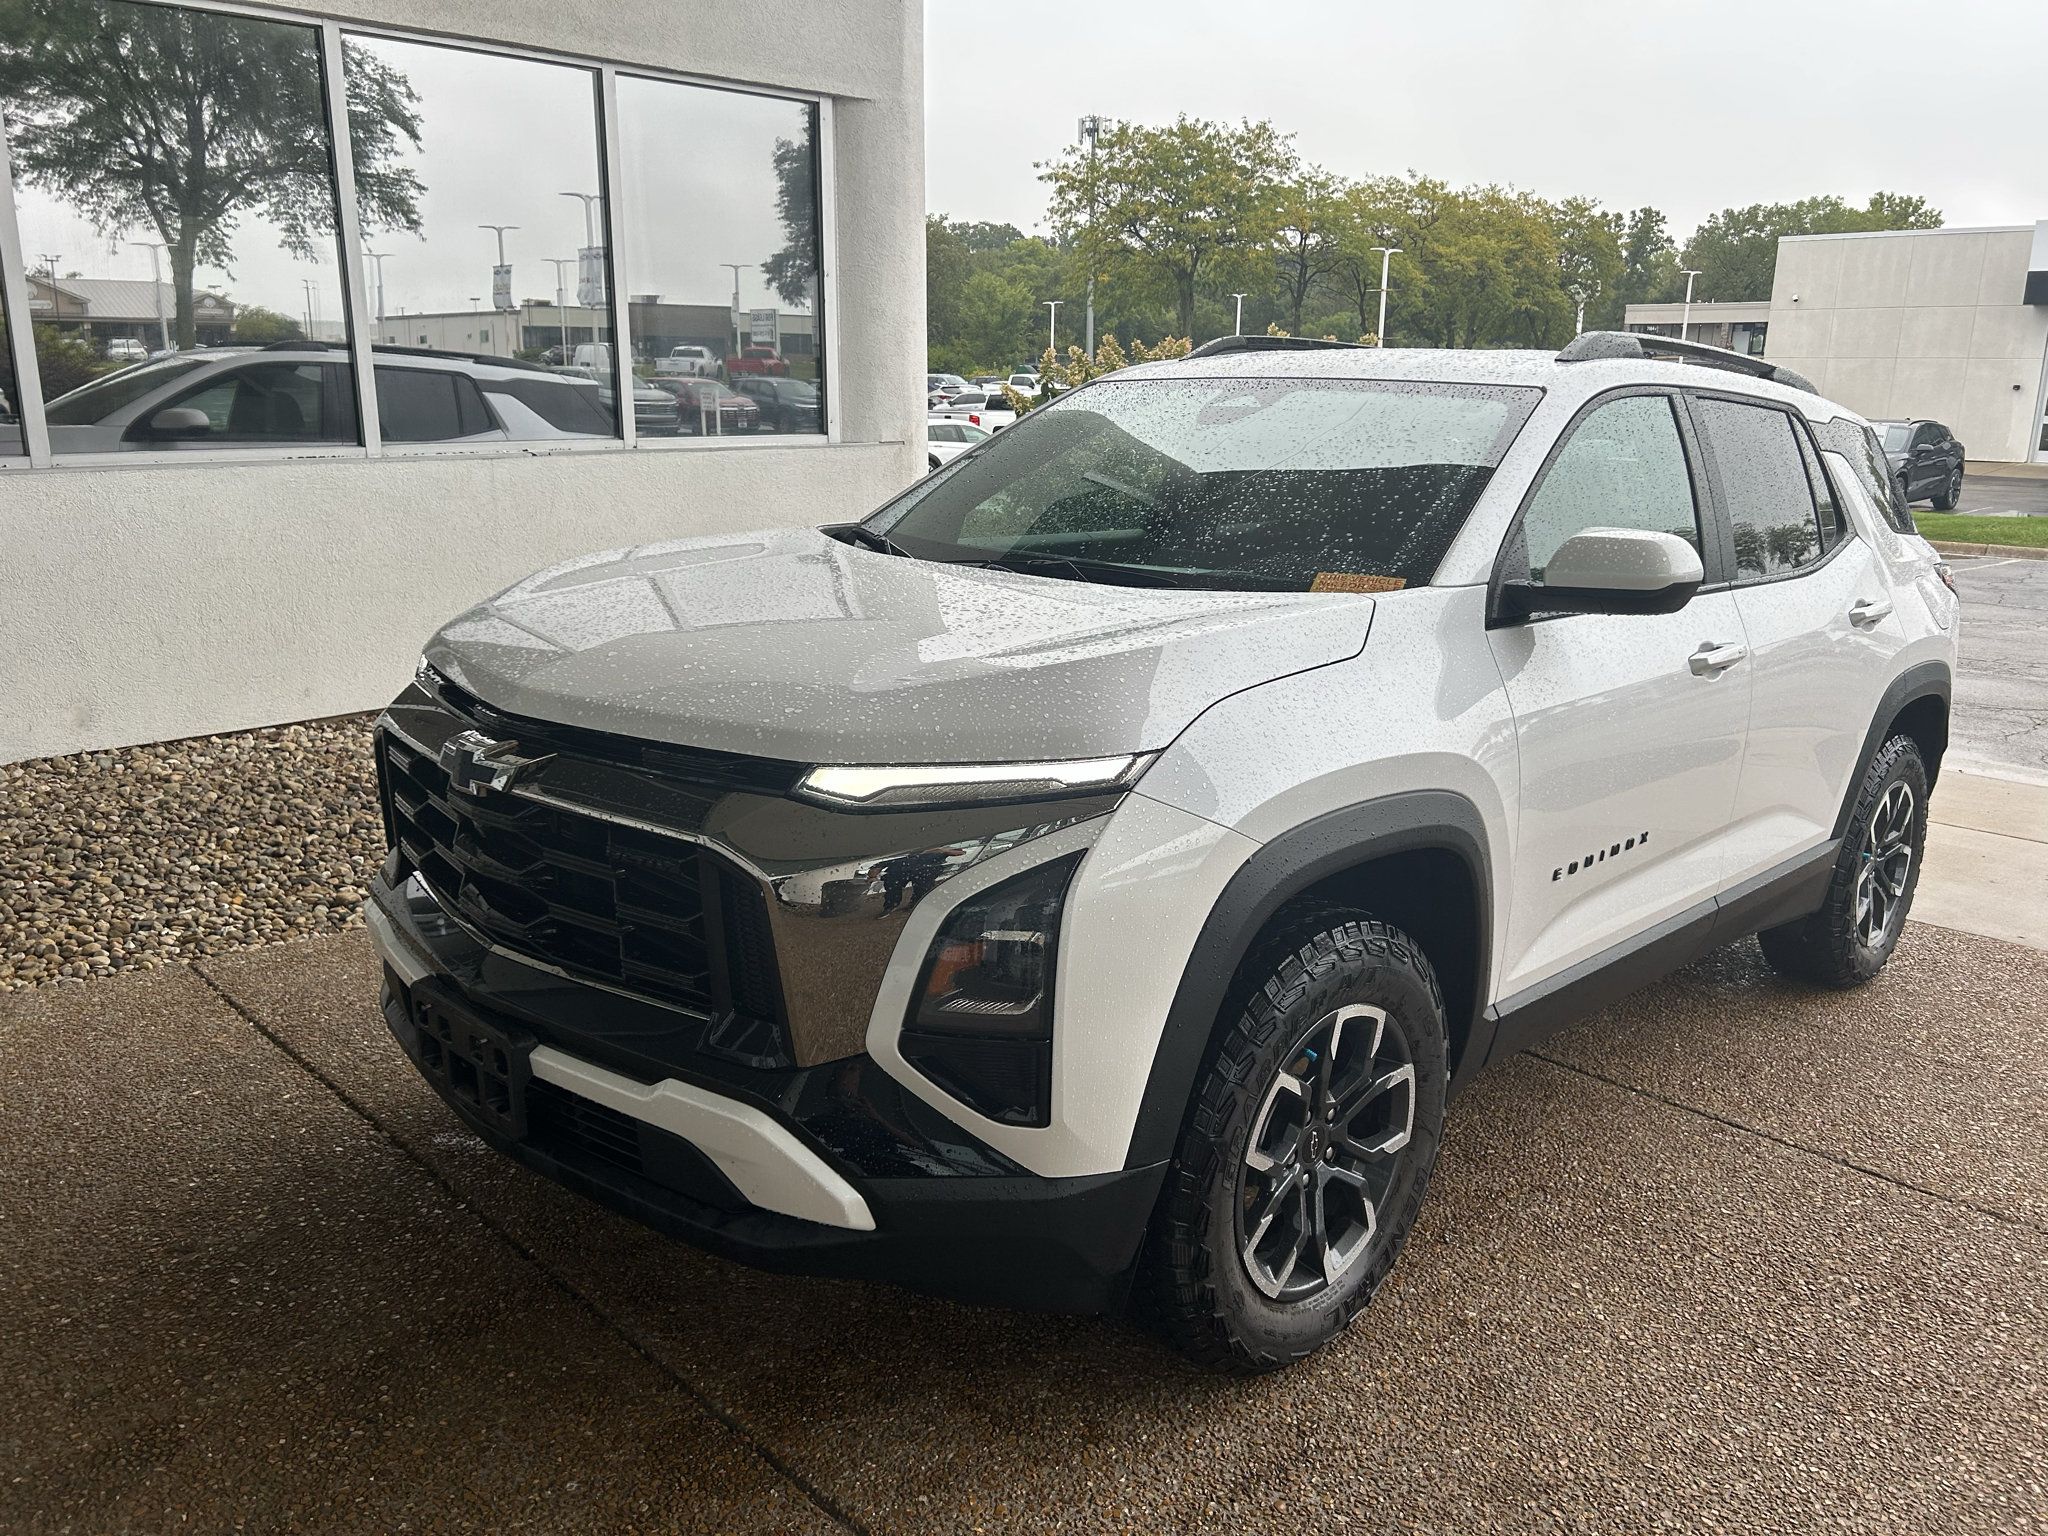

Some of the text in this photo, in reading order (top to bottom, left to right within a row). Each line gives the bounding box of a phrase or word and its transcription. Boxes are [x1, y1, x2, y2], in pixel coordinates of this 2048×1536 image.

[1341, 582, 1365, 590] FOR
[1351, 575, 1403, 587] VEHICLE
[1552, 831, 1649, 881] EQUINOX
[1323, 1167, 1429, 1333] GENERAL
